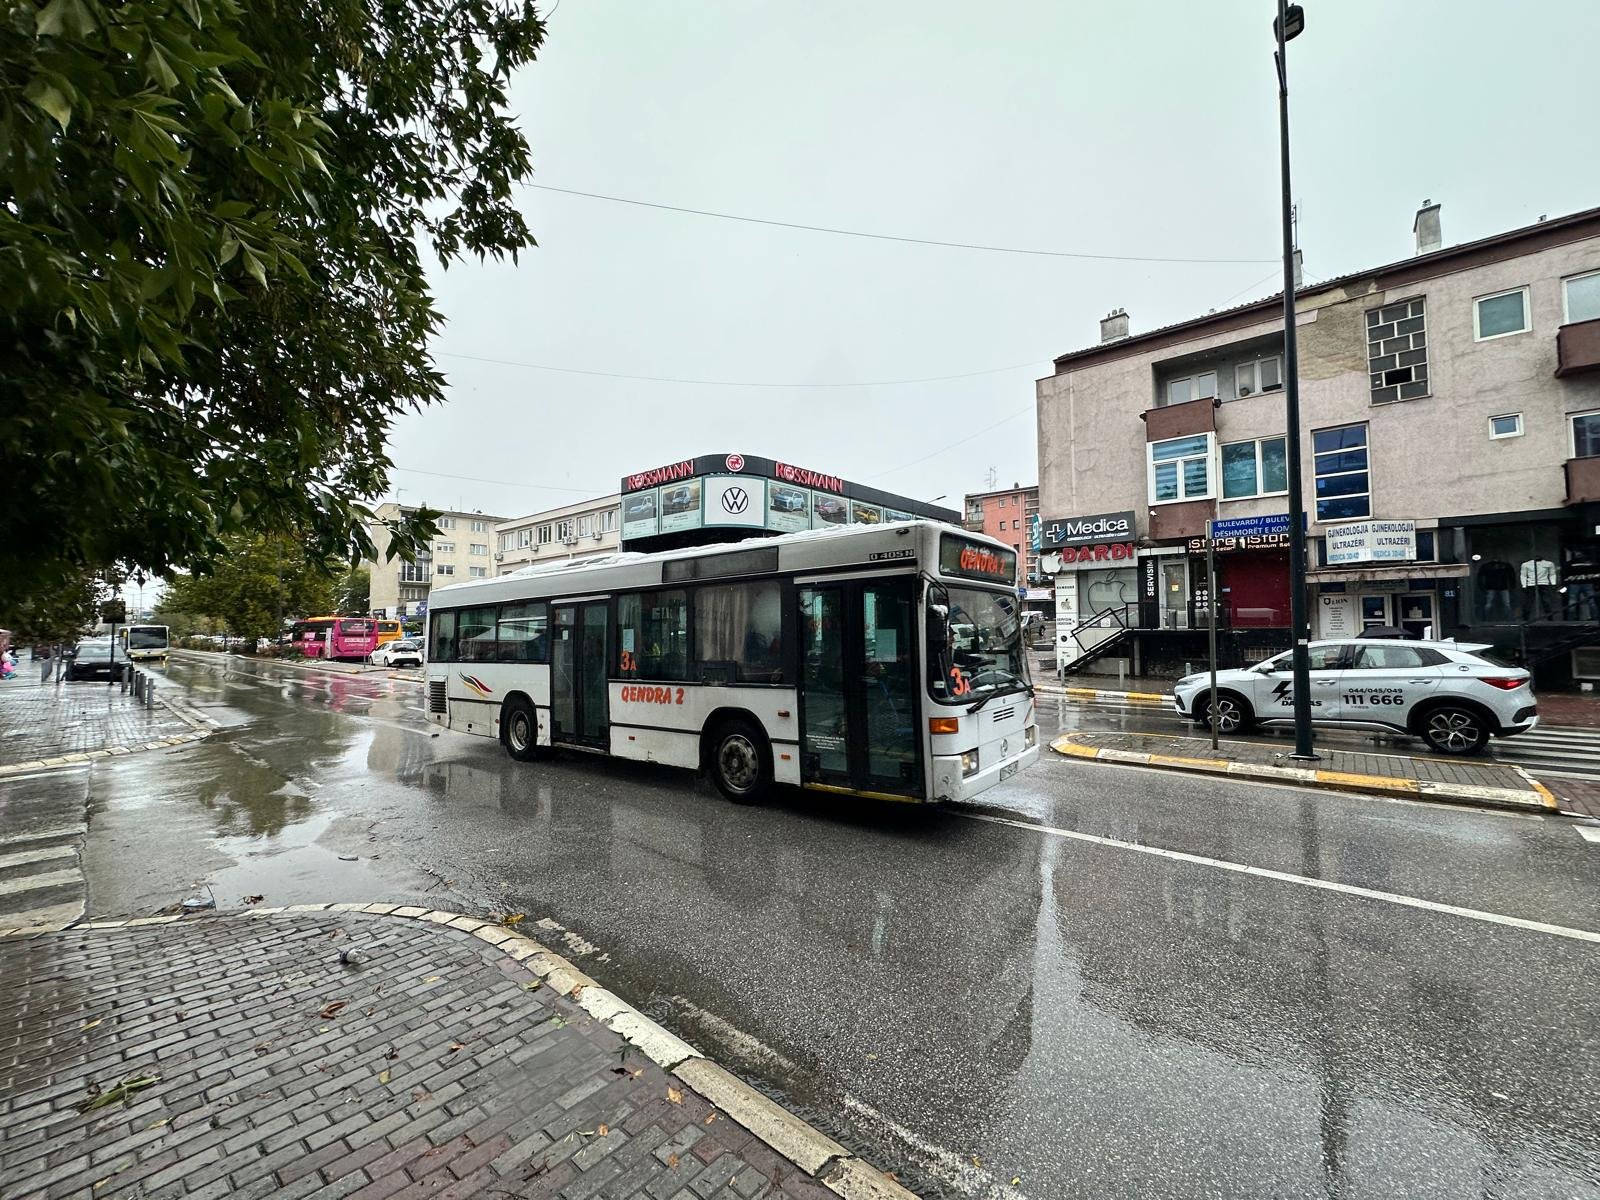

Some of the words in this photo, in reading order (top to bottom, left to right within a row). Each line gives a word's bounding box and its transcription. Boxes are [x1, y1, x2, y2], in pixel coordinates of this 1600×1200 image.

[627, 459, 694, 490] ROSSMANN
[775, 461, 843, 493] ROSSMANN
[1066, 518, 1128, 535] Medica
[1214, 527, 1263, 538] DËSHMORËT
[1264, 526, 1270, 534] E
[1271, 525, 1290, 533] KOM
[1217, 519, 1259, 528] BULEVARDI
[1265, 516, 1290, 524] BULEV
[960, 549, 998, 573] QENDRA
[1062, 543, 1134, 563] DARDI
[1147, 560, 1155, 596] SERVISIM
[621, 685, 672, 705] QENDRA
[675, 687, 684, 705] 2
[1342, 694, 1364, 706] 111
[1369, 694, 1405, 706] 666
